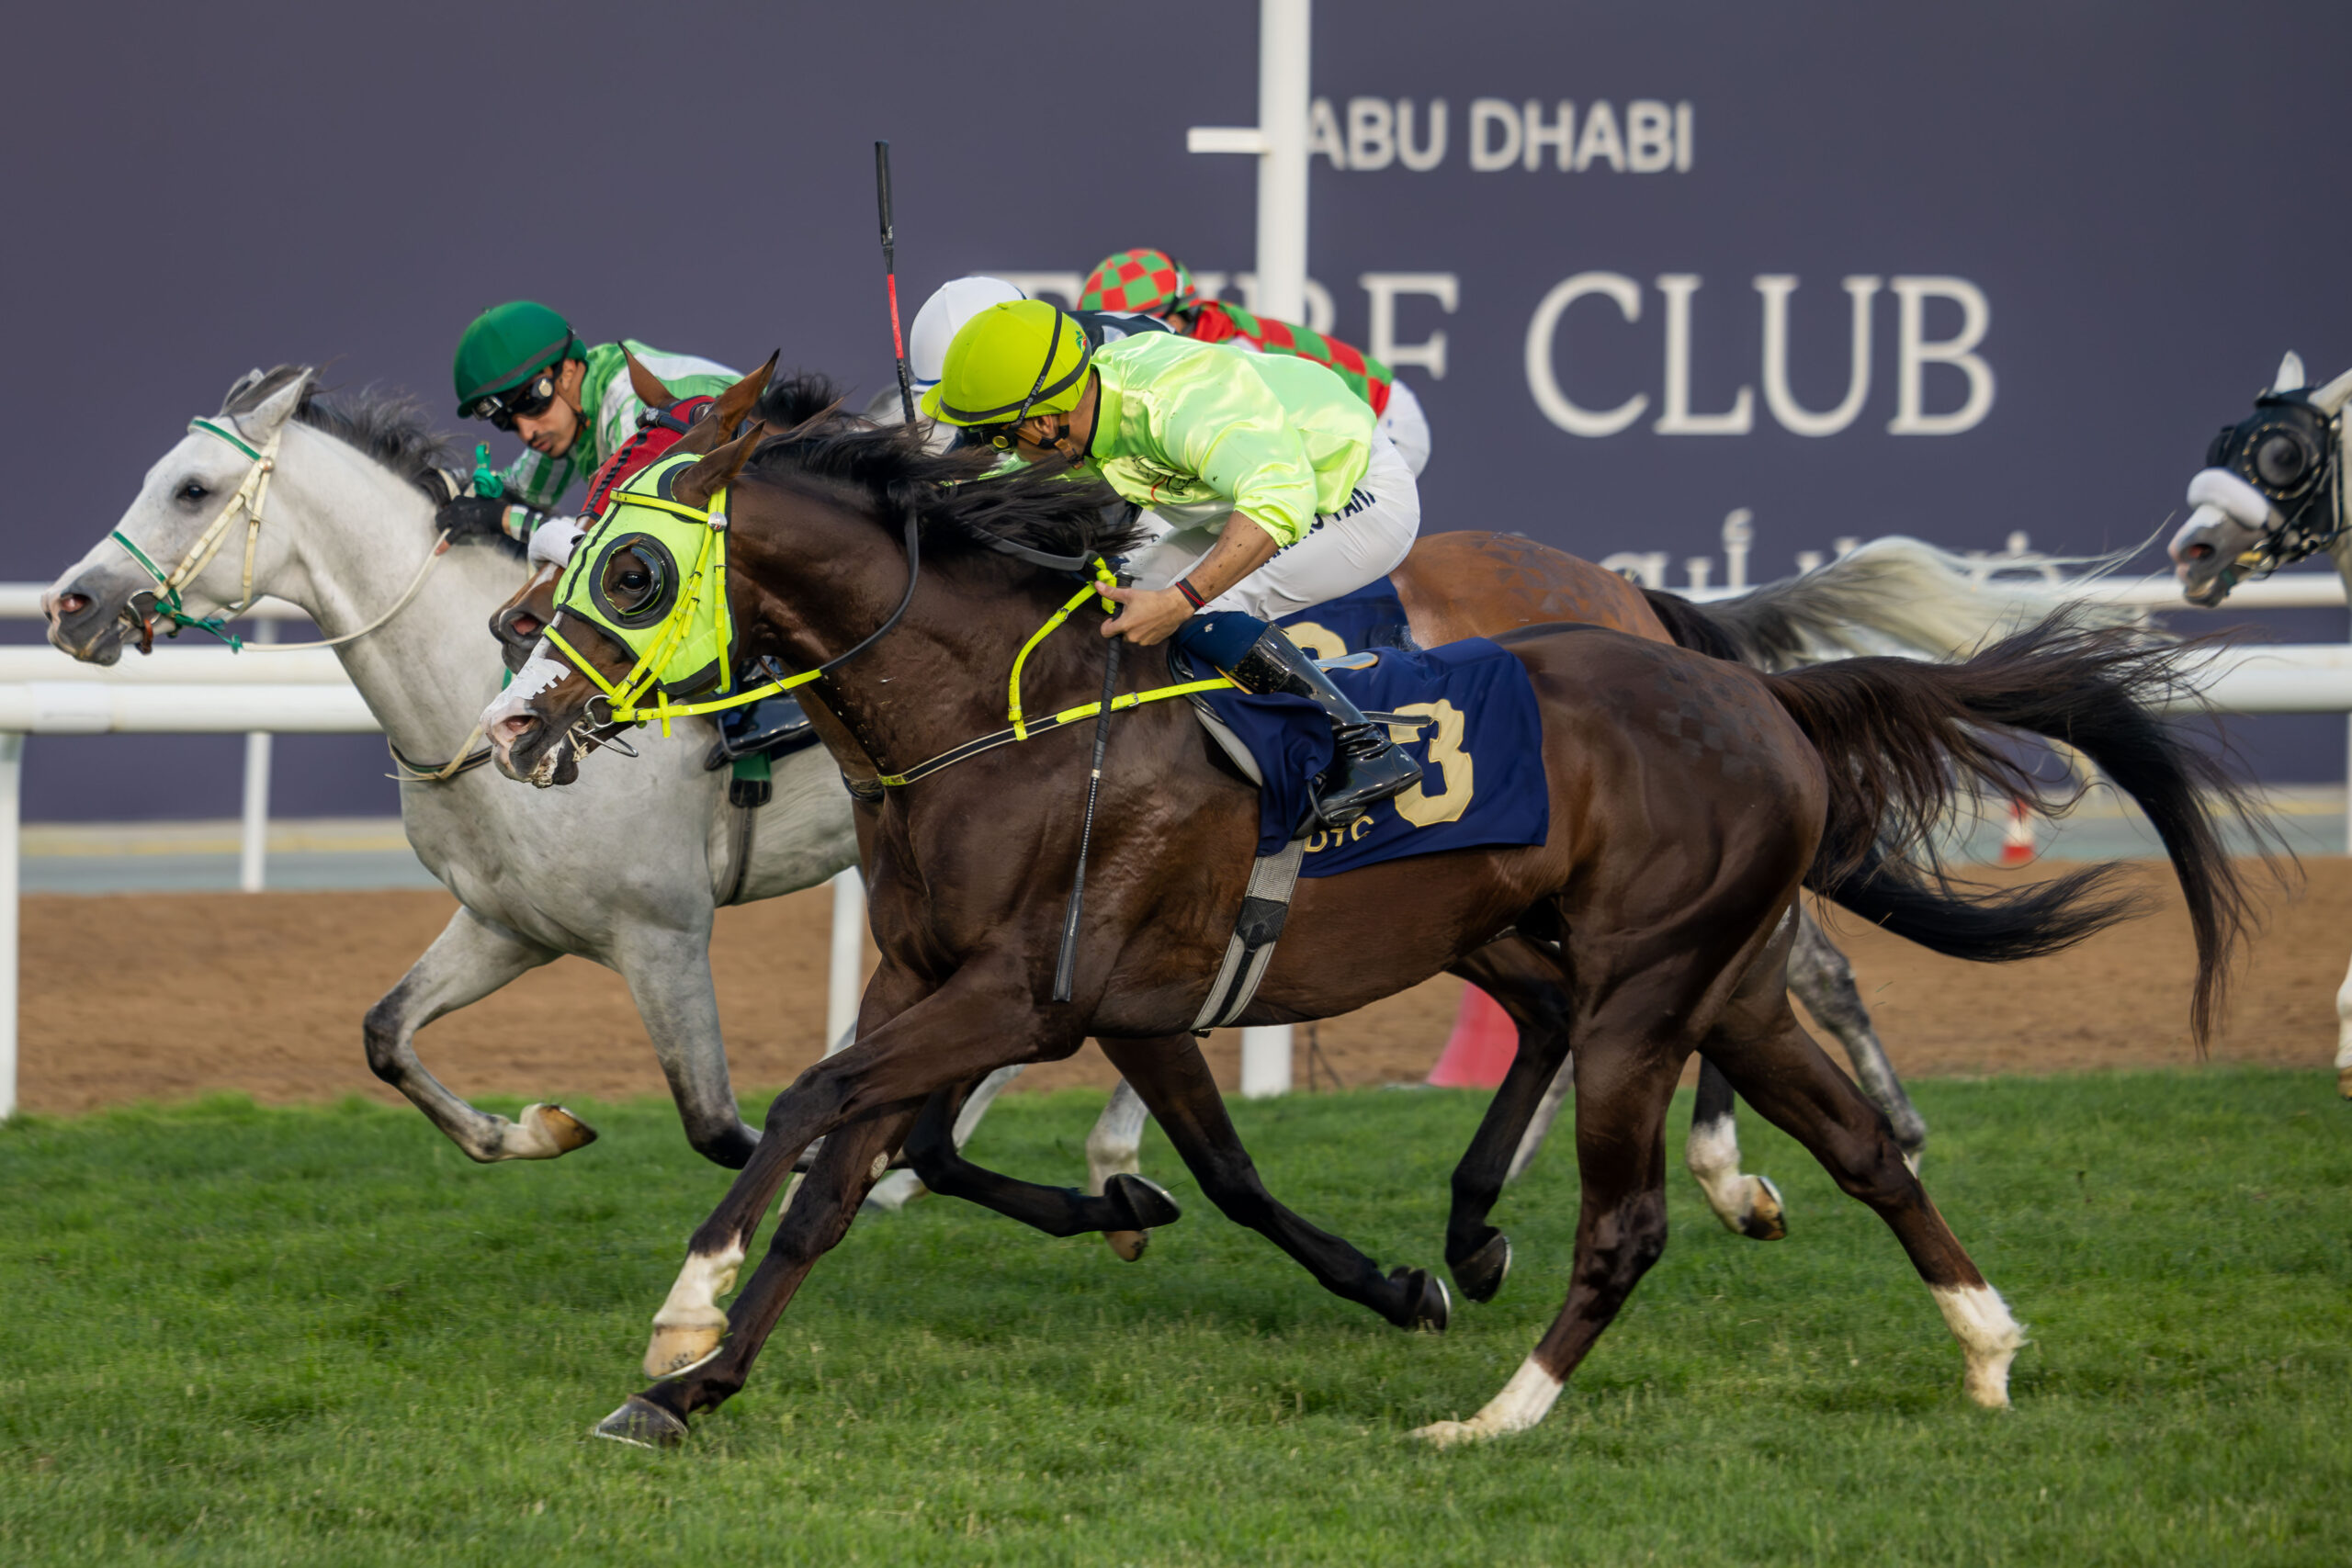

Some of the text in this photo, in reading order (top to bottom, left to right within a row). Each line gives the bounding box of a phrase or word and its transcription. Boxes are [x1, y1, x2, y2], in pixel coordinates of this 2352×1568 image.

[1309, 98, 1692, 173] ABU DHABI
[1525, 272, 1996, 437] CLUB
[1388, 698, 1474, 828] 3
